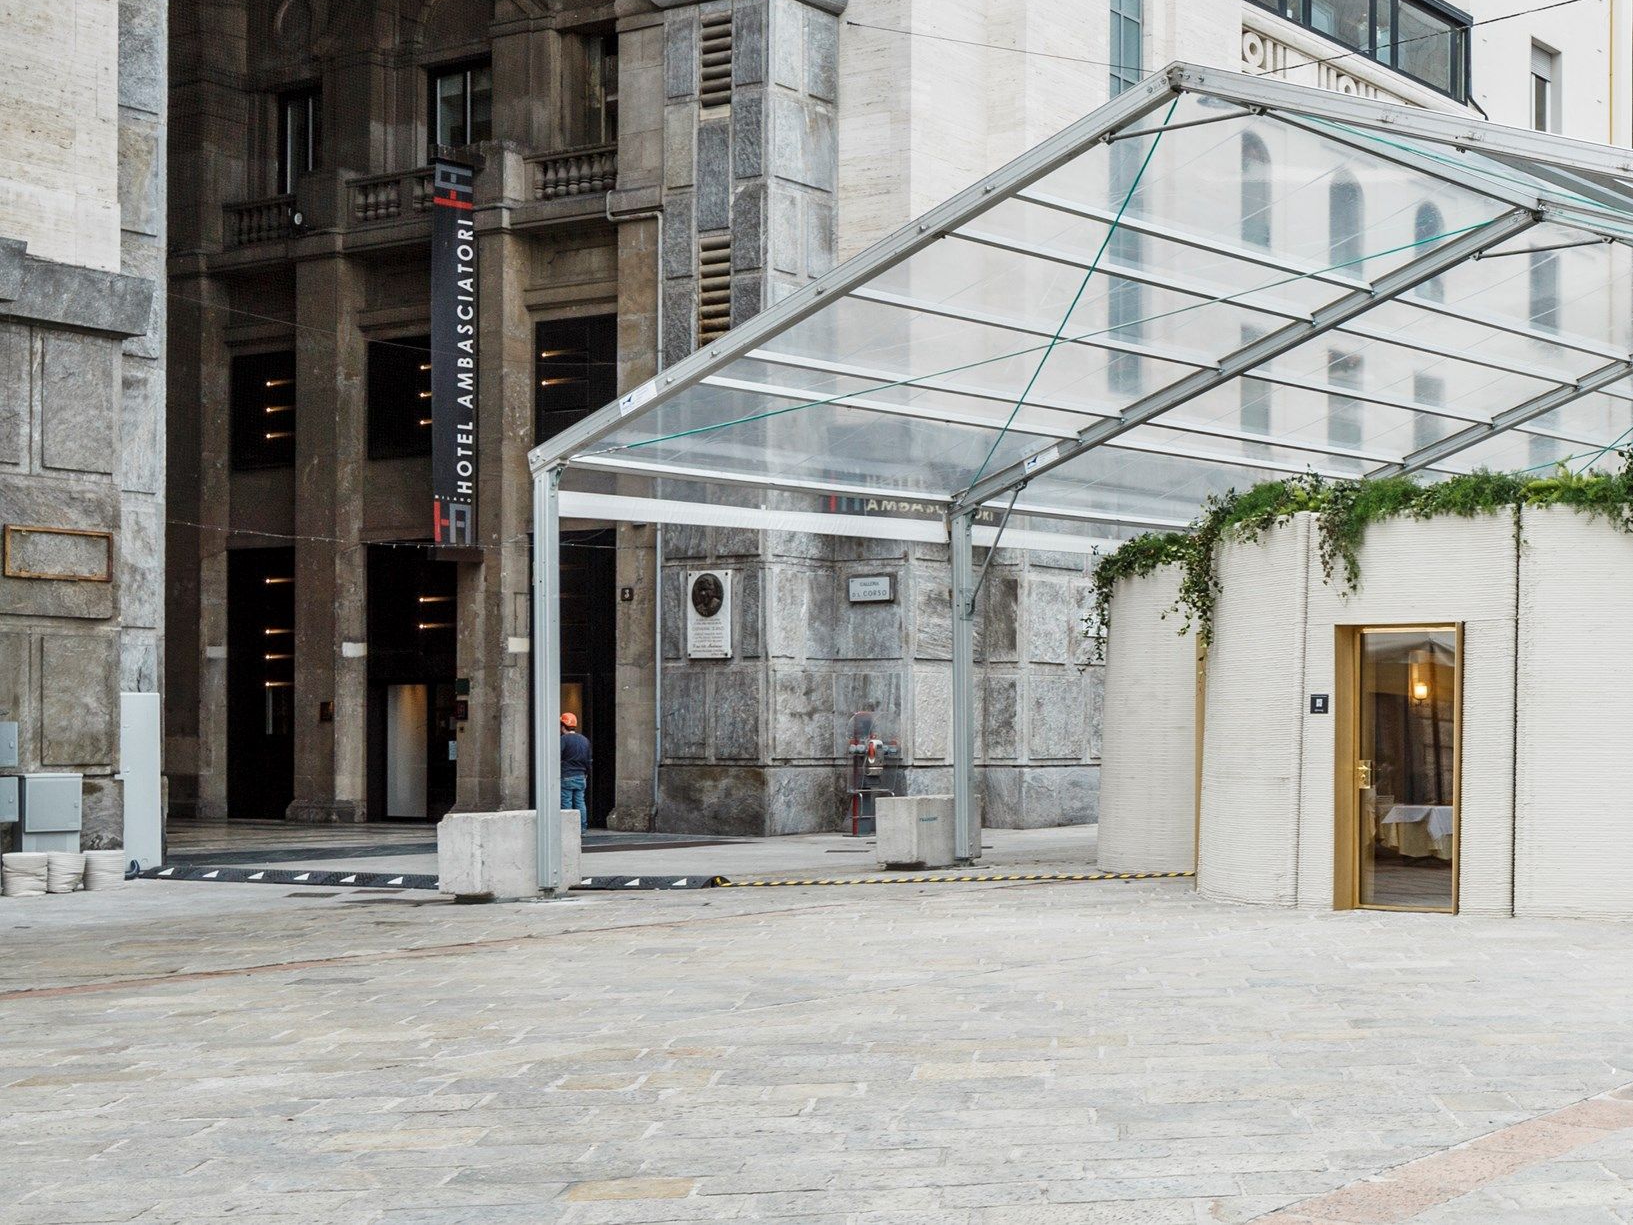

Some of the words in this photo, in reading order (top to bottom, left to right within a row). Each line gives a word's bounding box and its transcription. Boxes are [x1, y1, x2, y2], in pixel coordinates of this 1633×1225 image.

[457, 219, 474, 409] AMBASCIATORI
[456, 421, 473, 494] HOTEL
[863, 589, 887, 597] CORSO
